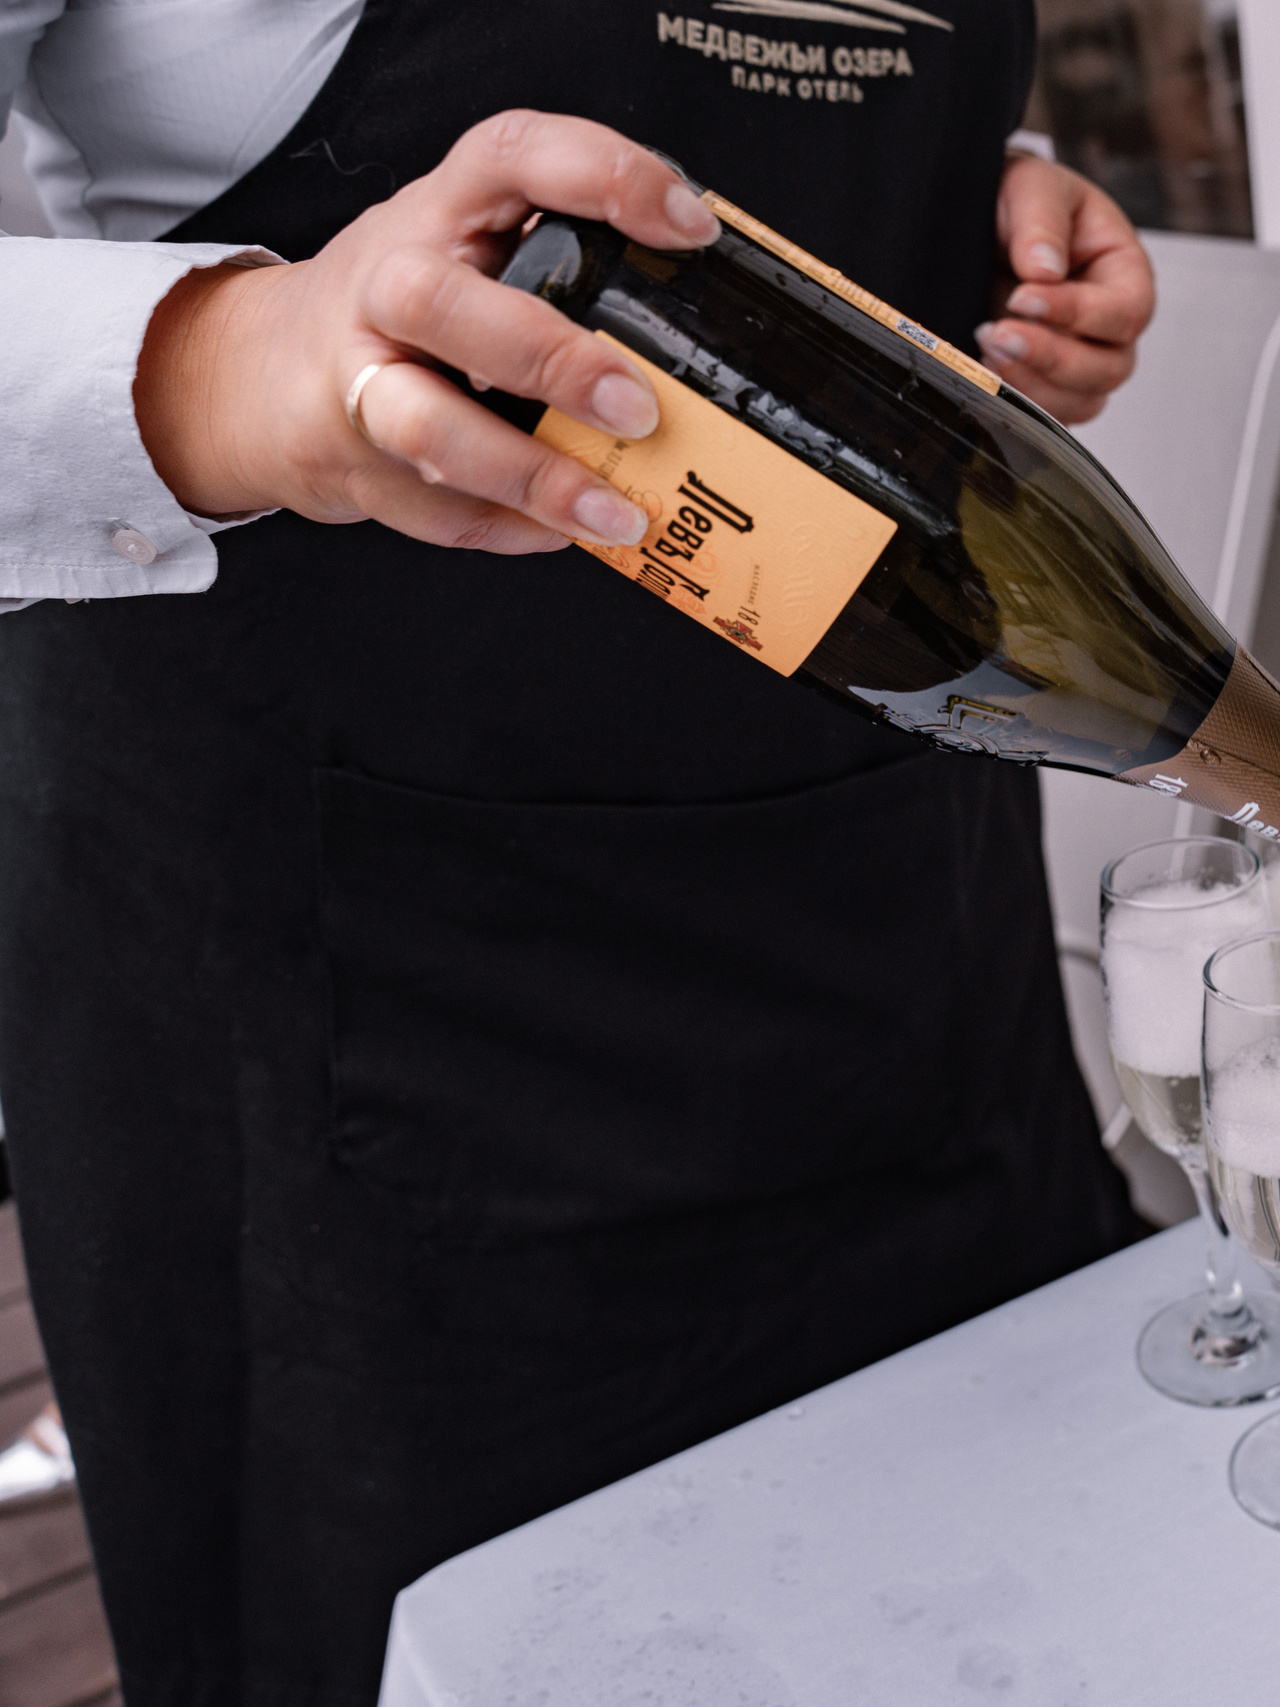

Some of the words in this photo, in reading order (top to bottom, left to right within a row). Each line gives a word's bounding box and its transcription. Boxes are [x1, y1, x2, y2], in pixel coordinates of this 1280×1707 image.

[657, 12, 827, 75] МЕДВЕЖЬИ
[832, 46, 914, 77] ОЗЕРА
[731, 65, 791, 97] ПАРК
[796, 78, 864, 104] ОТЕЛЬ
[654, 470, 755, 562] Левъ
